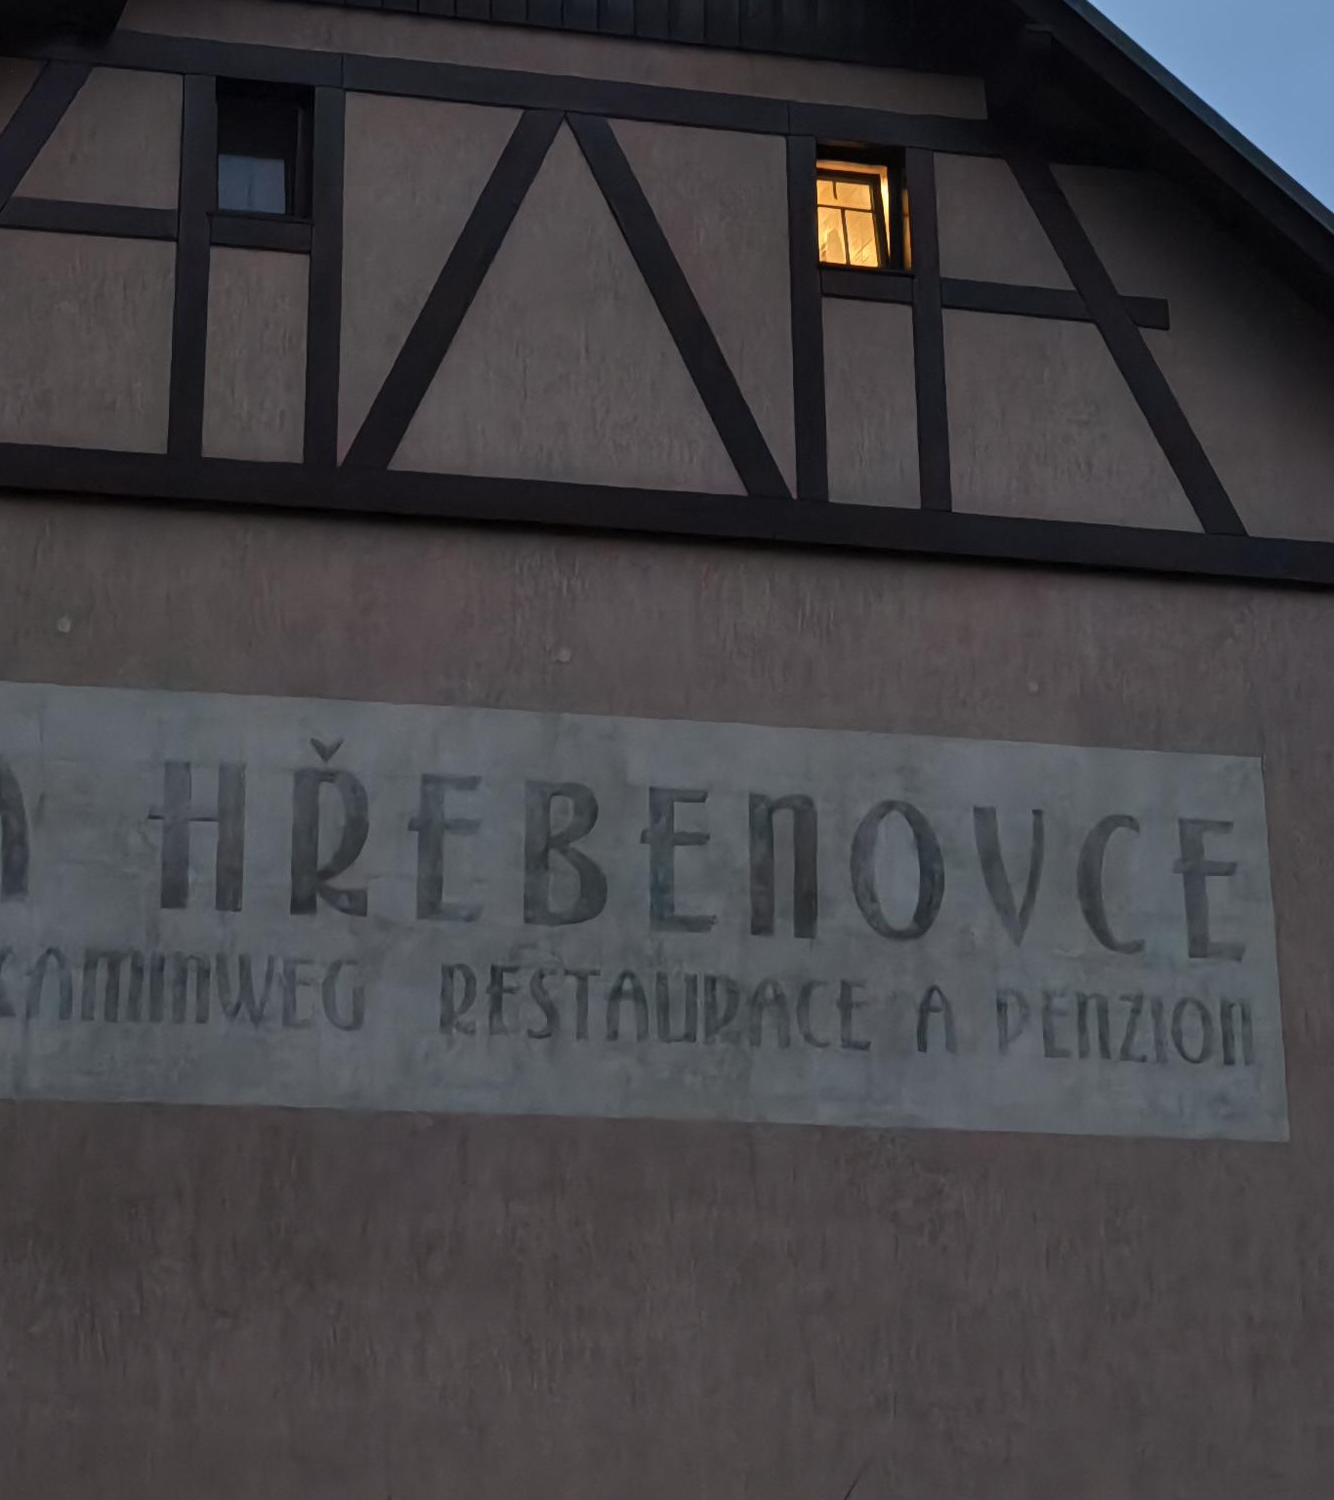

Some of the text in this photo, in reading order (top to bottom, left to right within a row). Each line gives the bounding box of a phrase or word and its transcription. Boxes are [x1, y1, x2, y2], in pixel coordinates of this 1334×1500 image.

[147, 738, 1247, 964] HŘEBENOVCE
[440, 964, 873, 1051] RESTAURACE
[916, 985, 957, 1055] A
[998, 990, 1255, 1067] PENZION
